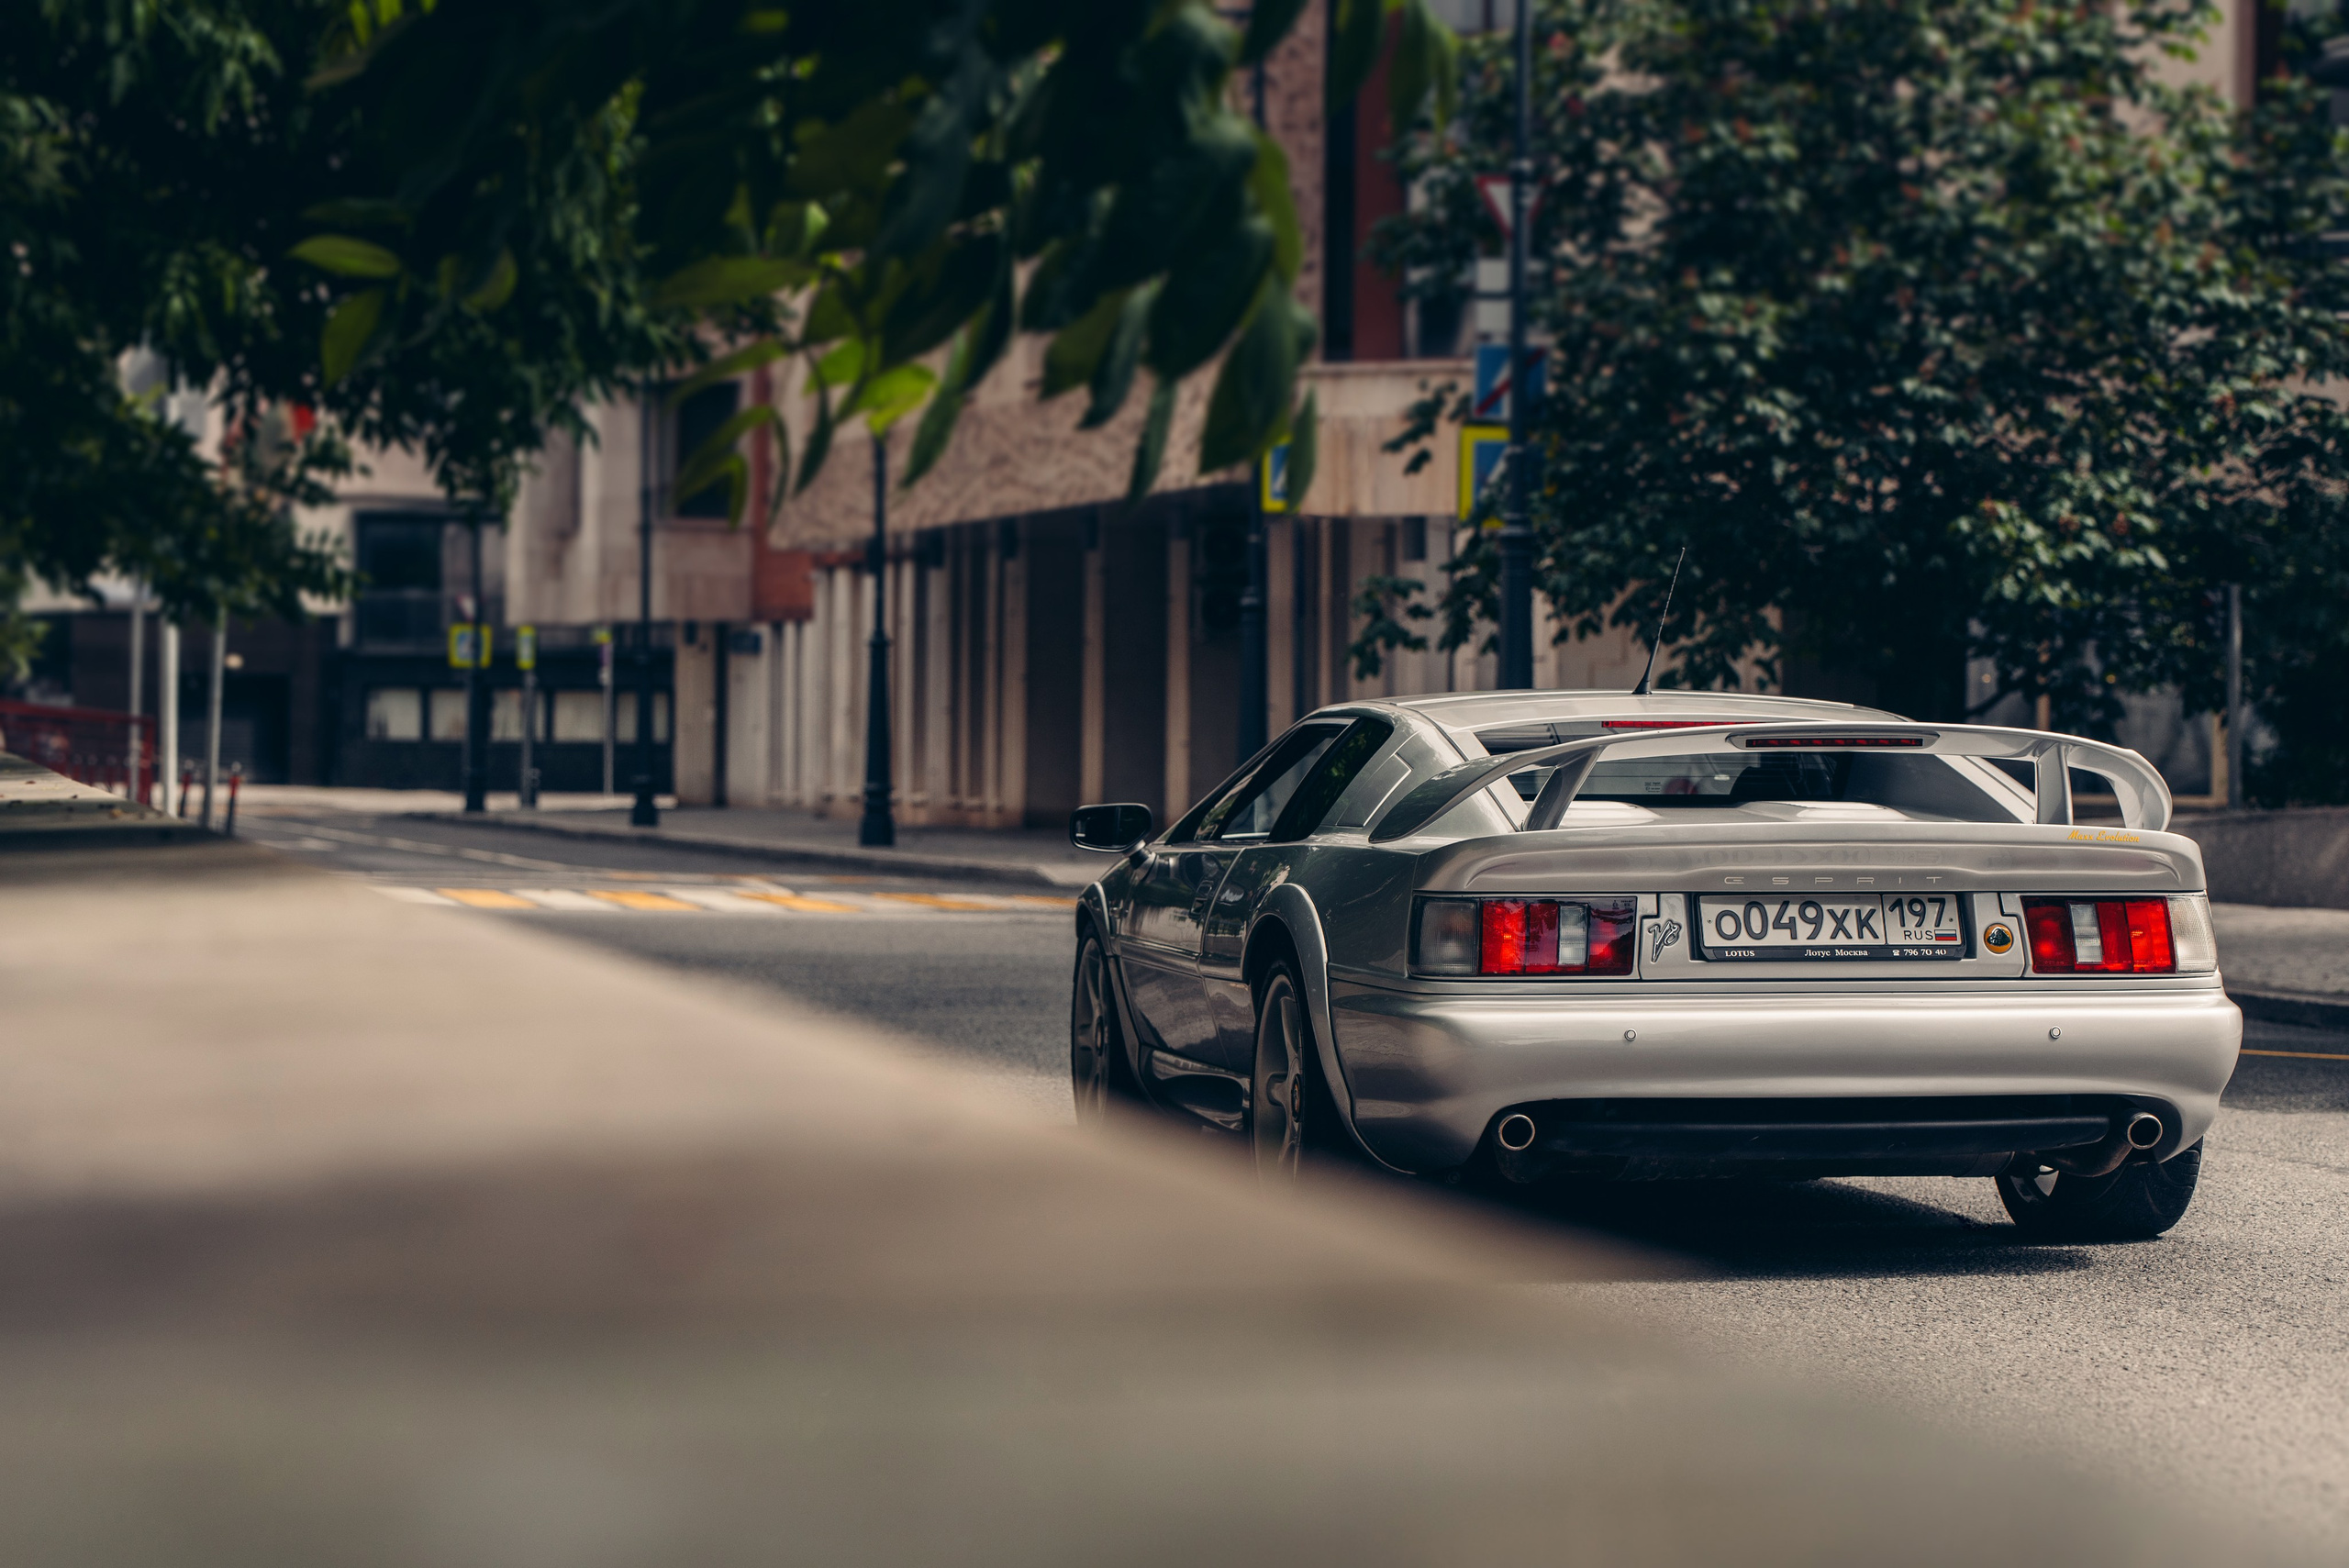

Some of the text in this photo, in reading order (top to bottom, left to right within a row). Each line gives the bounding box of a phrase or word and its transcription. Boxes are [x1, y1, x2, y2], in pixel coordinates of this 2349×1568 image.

[2067, 829, 2140, 842] Maxx Evolution
[1724, 876, 1943, 884] ESPRIT
[1888, 897, 1946, 928] 197
[1903, 929, 1933, 940] RUS
[1804, 949, 1831, 958] Лотус
